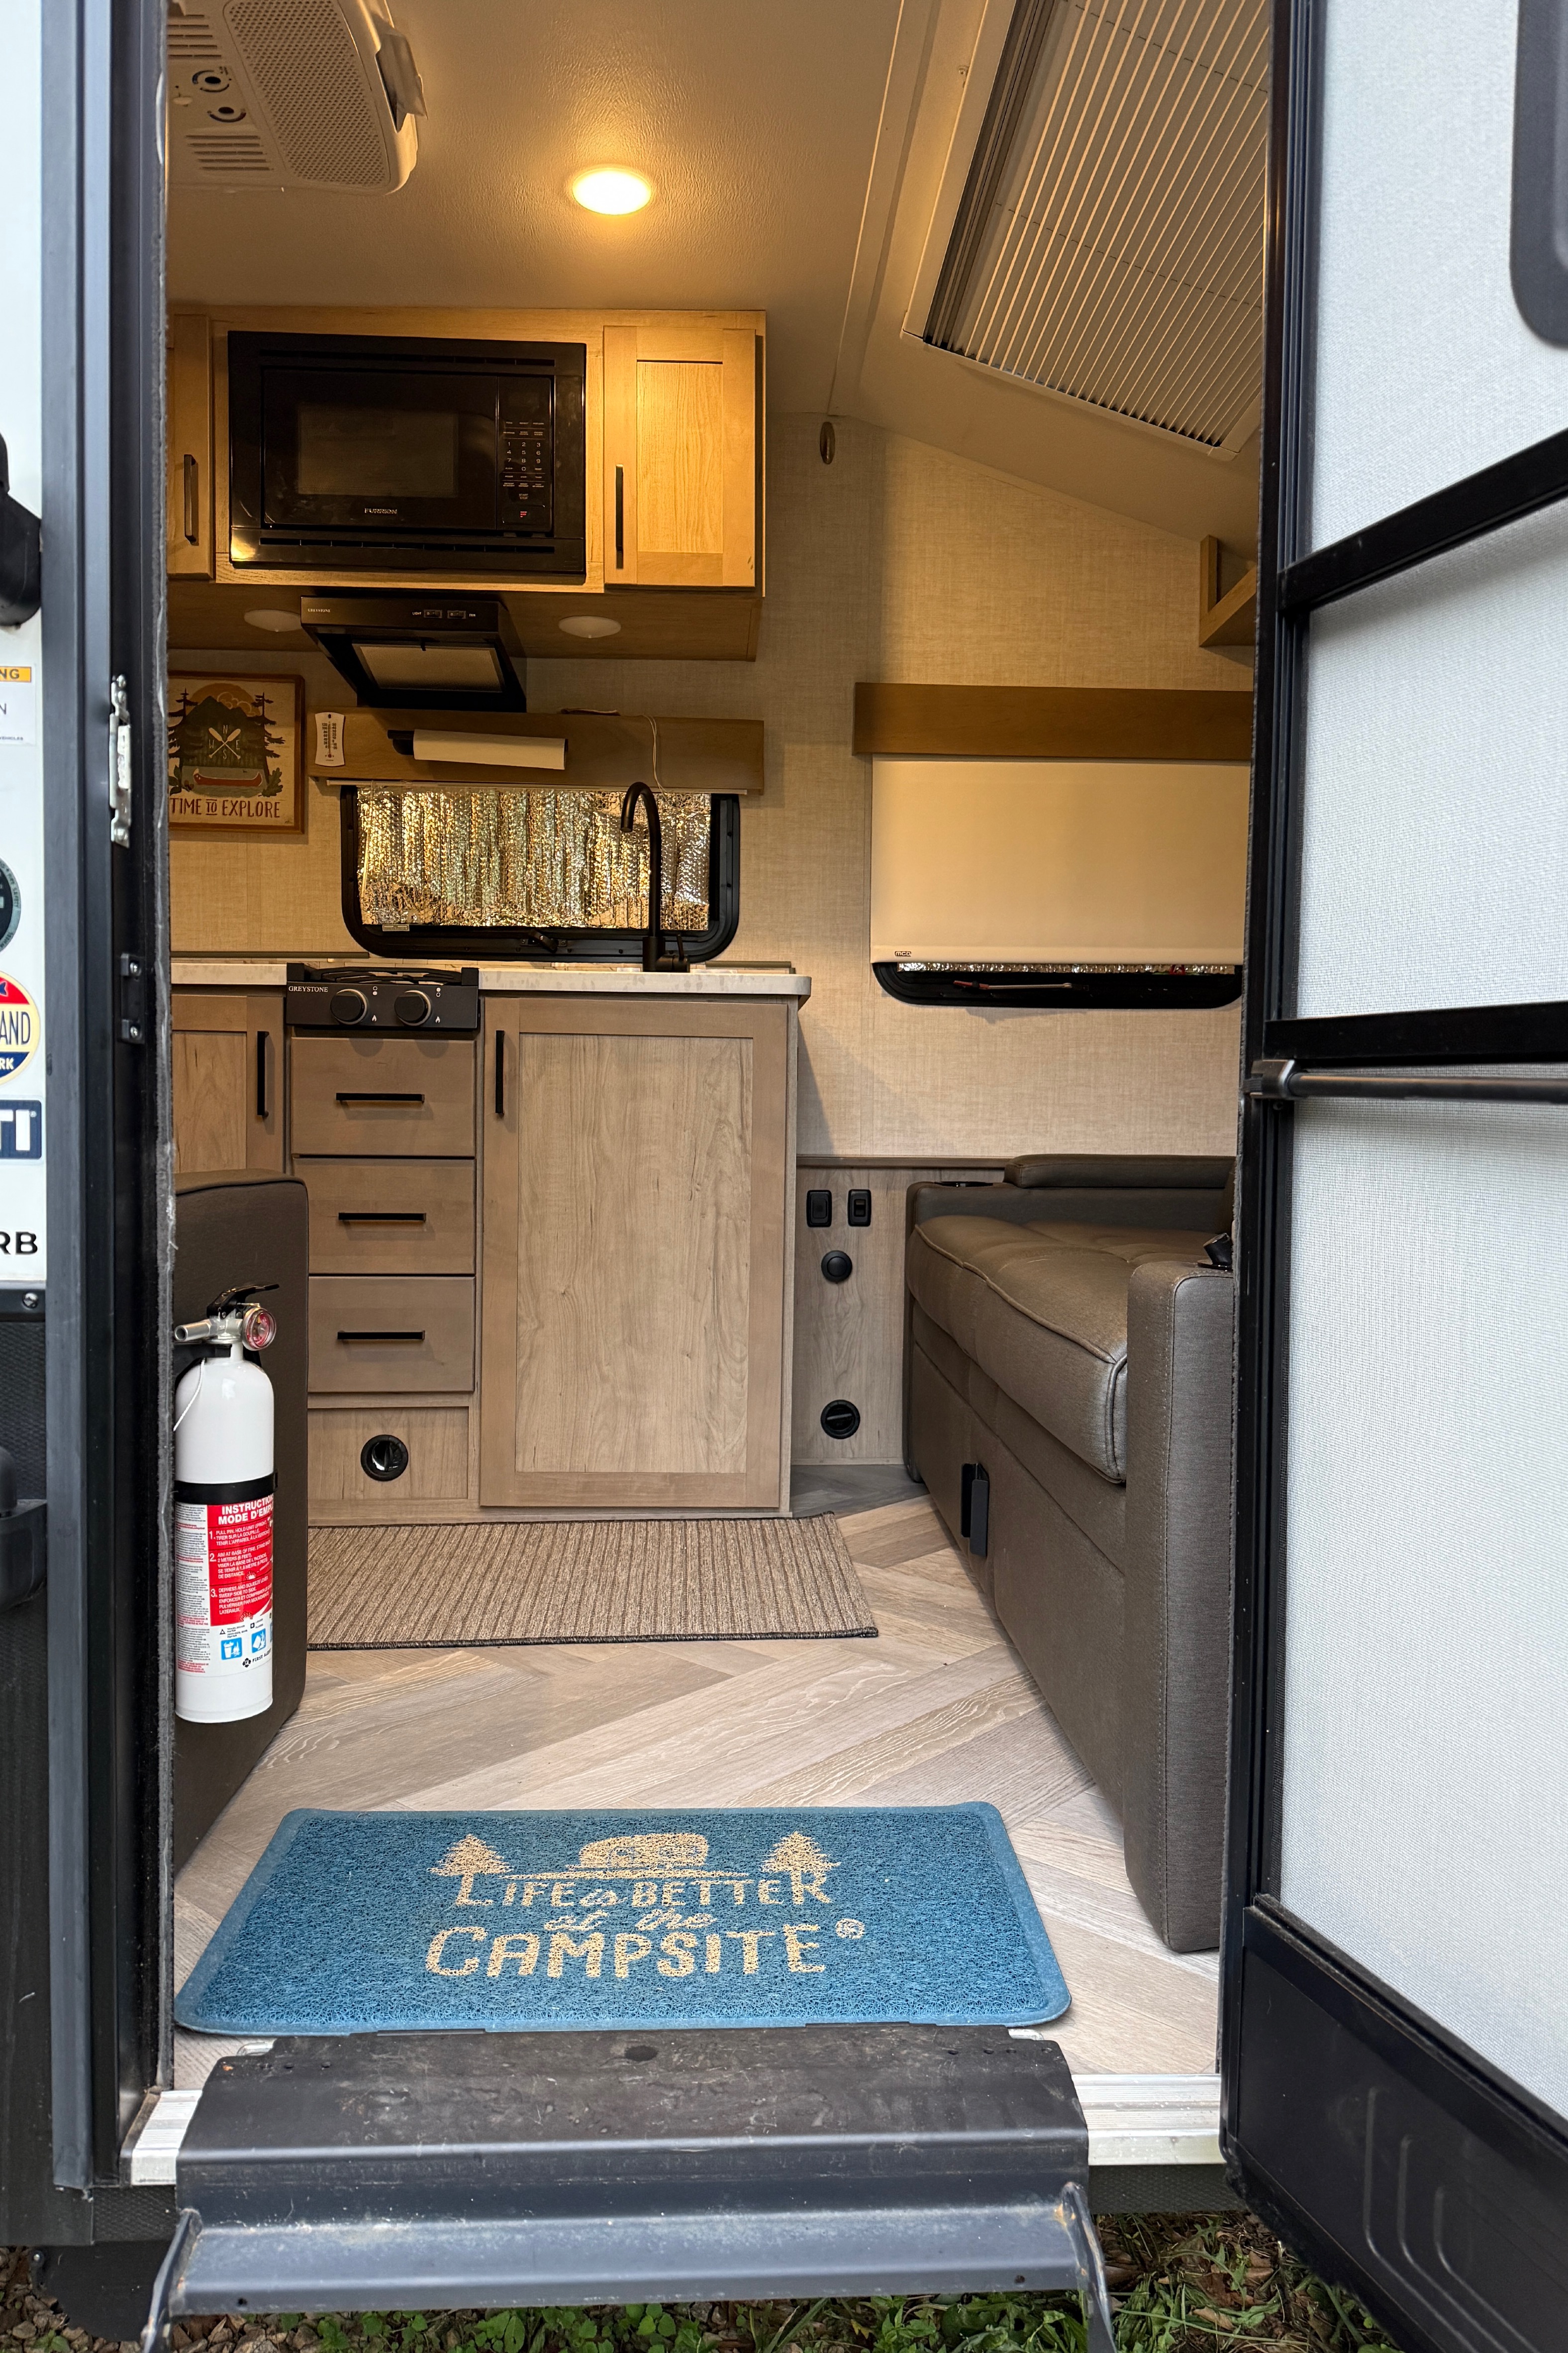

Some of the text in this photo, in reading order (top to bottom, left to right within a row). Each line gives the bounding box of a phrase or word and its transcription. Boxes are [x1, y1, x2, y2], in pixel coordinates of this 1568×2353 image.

[223, 724, 228, 734] N
[236, 739, 240, 750] E
[170, 798, 281, 818] TIME TO EXPLORE
[218, 1513, 248, 1525] MODE
[251, 1501, 273, 1520] D'EMPL
[455, 1873, 575, 1908] LIFE
[631, 1869, 834, 1908] BETTER
[424, 1923, 826, 1979] CAMPSITE
